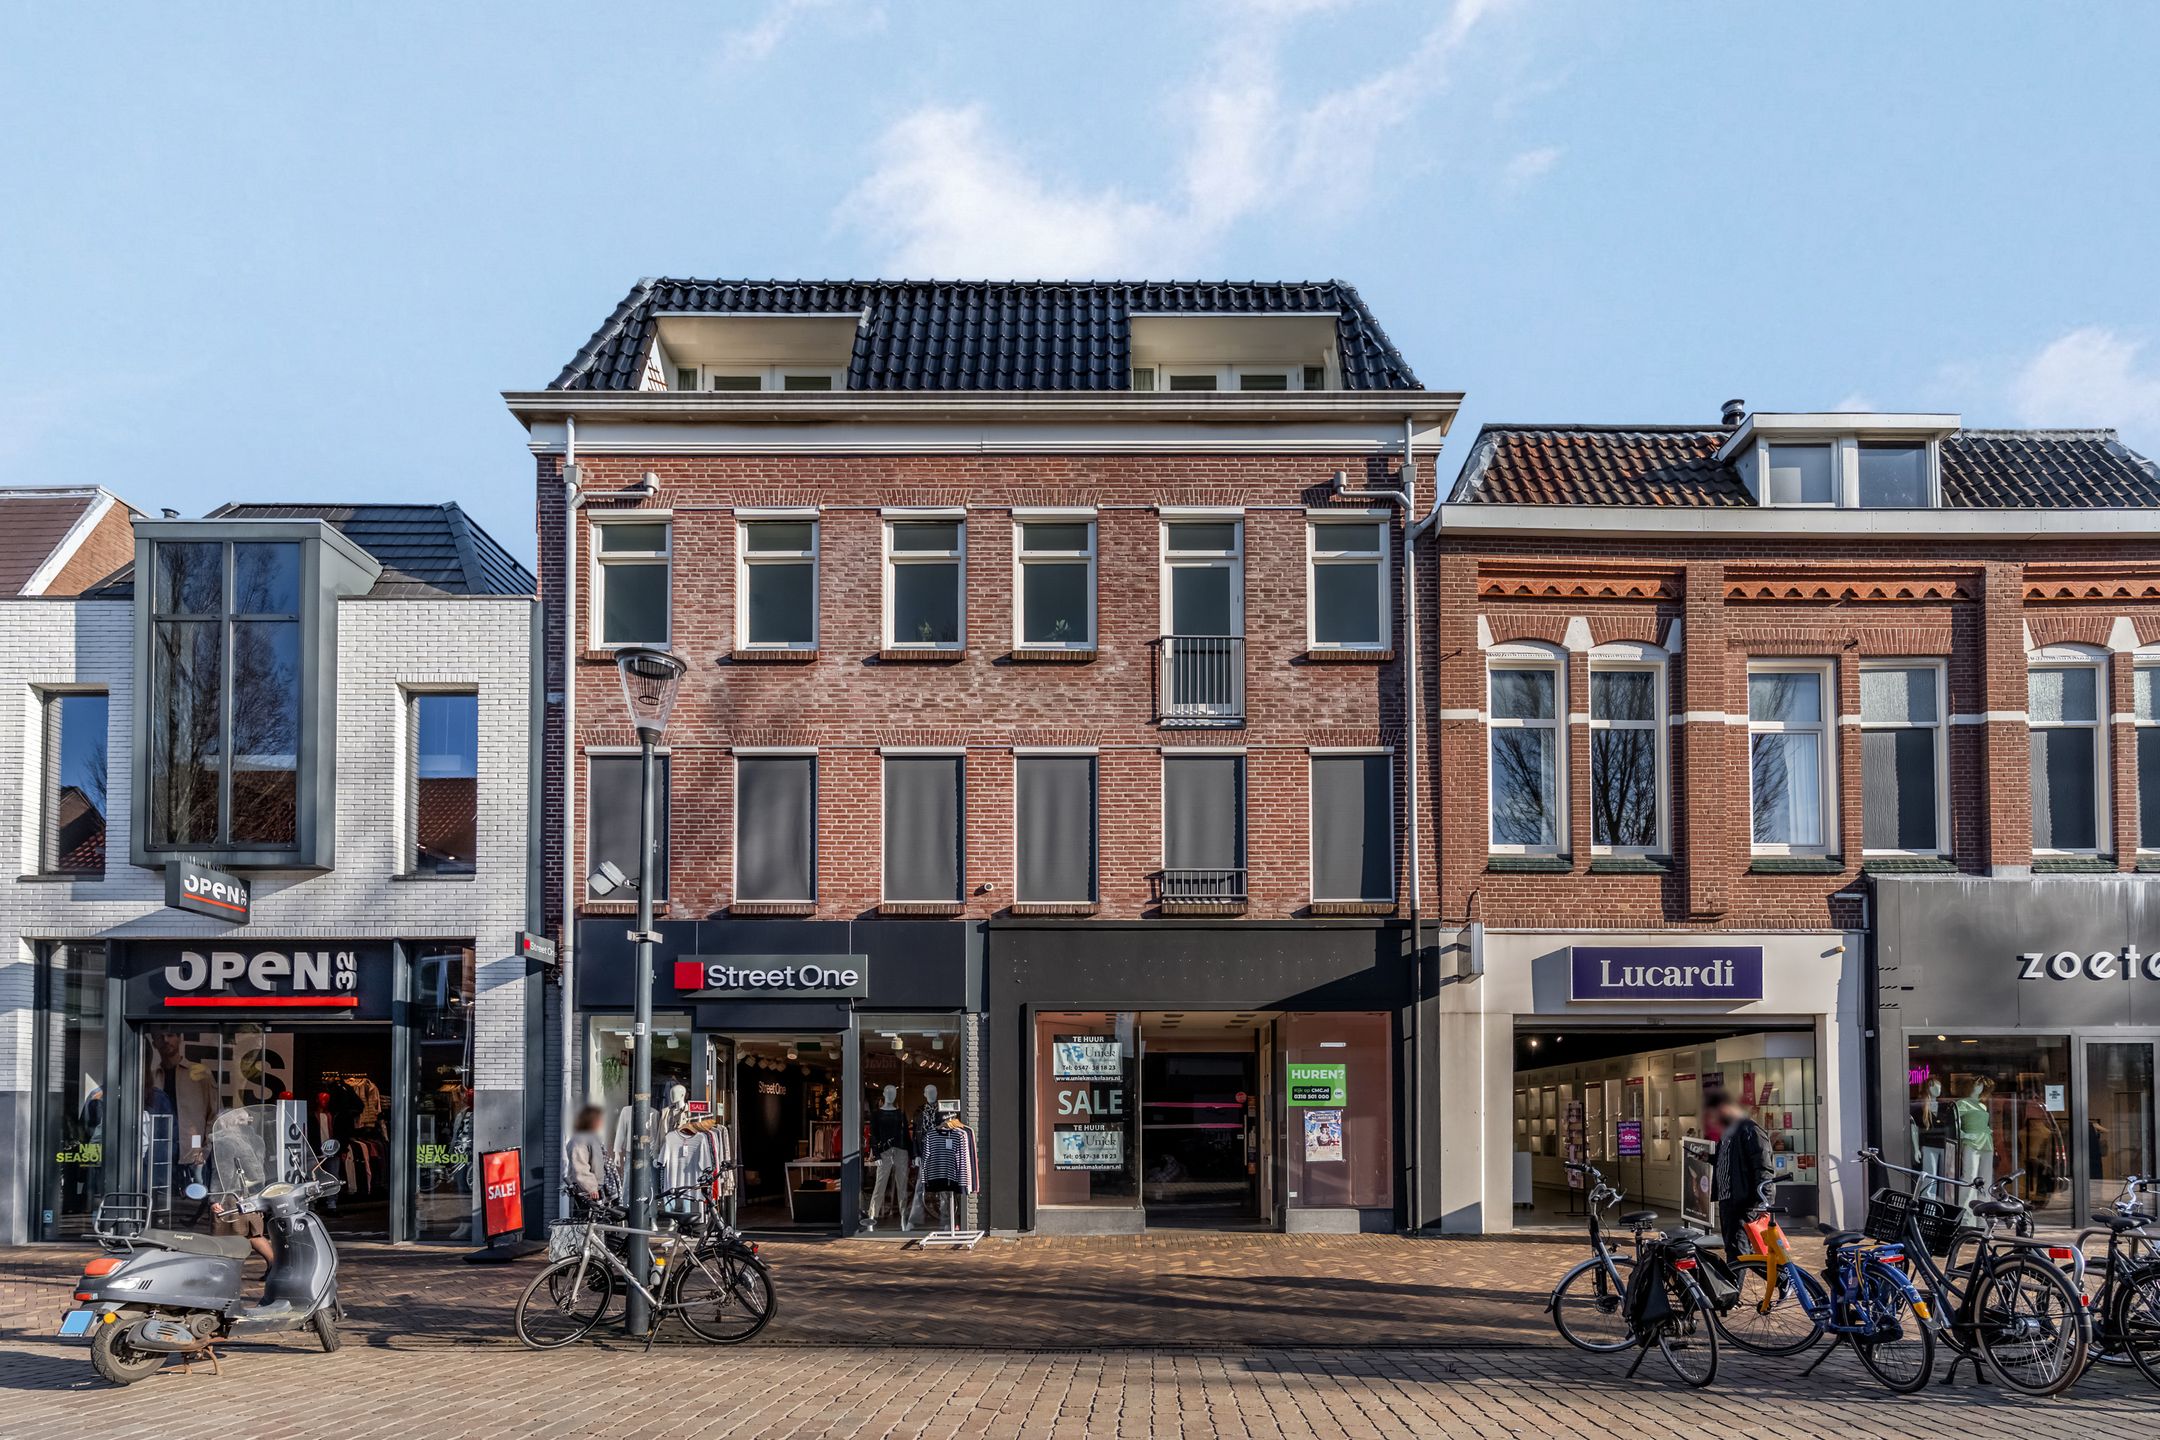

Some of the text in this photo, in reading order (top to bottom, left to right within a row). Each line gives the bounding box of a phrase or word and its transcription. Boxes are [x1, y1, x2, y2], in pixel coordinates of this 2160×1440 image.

[335, 951, 357, 991] 32
[707, 964, 859, 987] Street One
[1600, 960, 1735, 987] Lucardi
[1085, 1045, 1116, 1058] Uniek
[1291, 1069, 1345, 1080] HUREN?
[758, 1080, 775, 1095] Street
[1058, 1089, 1123, 1115] SALE
[1086, 1134, 1117, 1146] Uniek
[416, 1144, 447, 1154] NEW
[416, 1153, 469, 1164] SEASON
[488, 1181, 517, 1201] SALE!
